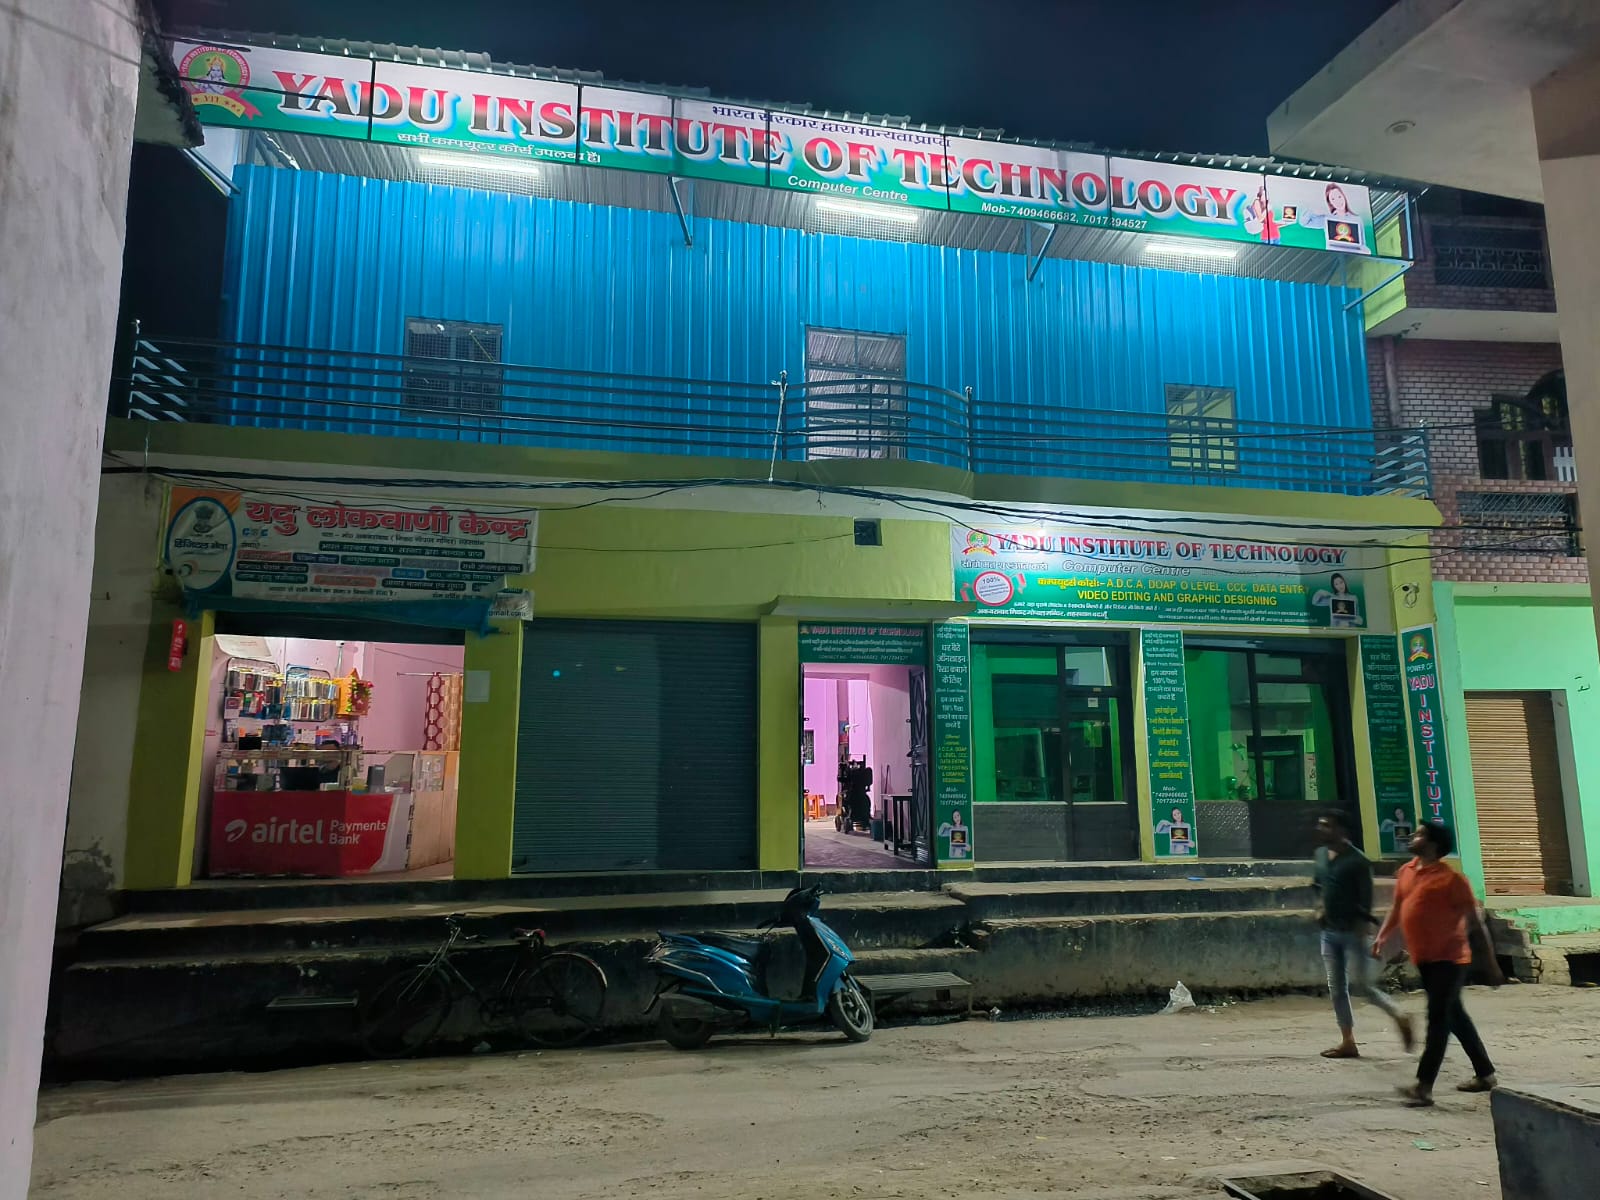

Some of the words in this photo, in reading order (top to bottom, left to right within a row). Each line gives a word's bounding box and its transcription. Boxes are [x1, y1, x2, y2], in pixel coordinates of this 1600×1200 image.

[712, 105, 755, 121] भारत
[759, 112, 819, 129] सरकार
[858, 126, 913, 143] मान्यता
[272, 70, 450, 125] YADU
[470, 95, 786, 166] INSTITUTE
[803, 136, 878, 177] OF
[892, 147, 1238, 220] TECHNOLOGY
[398, 132, 430, 144] सभी
[498, 142, 535, 155] कोर्स
[787, 175, 859, 195] Computer
[861, 184, 909, 202] Centre
[981, 202, 1081, 224] Mob-7409466682,
[1082, 213, 1148, 230] 7017294527
[245, 502, 300, 536] यदु
[306, 500, 453, 534] लोकवाणी
[457, 508, 532, 541] केन्द्र
[995, 533, 1053, 551] YADU
[1060, 536, 1168, 556] INSTITUTE
[1175, 542, 1203, 558] OF
[1209, 543, 1344, 564] TECHNOLOGY
[1062, 560, 1137, 576] Computer
[1141, 562, 1190, 577] Centre
[1077, 589, 1109, 600] VIDEO
[1111, 590, 1151, 602] EDITING
[1153, 592, 1175, 603] AND
[1176, 593, 1221, 604] GRAPHIC
[1223, 594, 1277, 606] DESIGNING
[1252, 583, 1277, 593] DATA
[1407, 663, 1426, 672] POWER
[1426, 662, 1434, 670] OF
[1407, 674, 1435, 691] YADU
[251, 816, 324, 845] airtel
[330, 819, 387, 833] Payments
[329, 832, 360, 845] Bank
